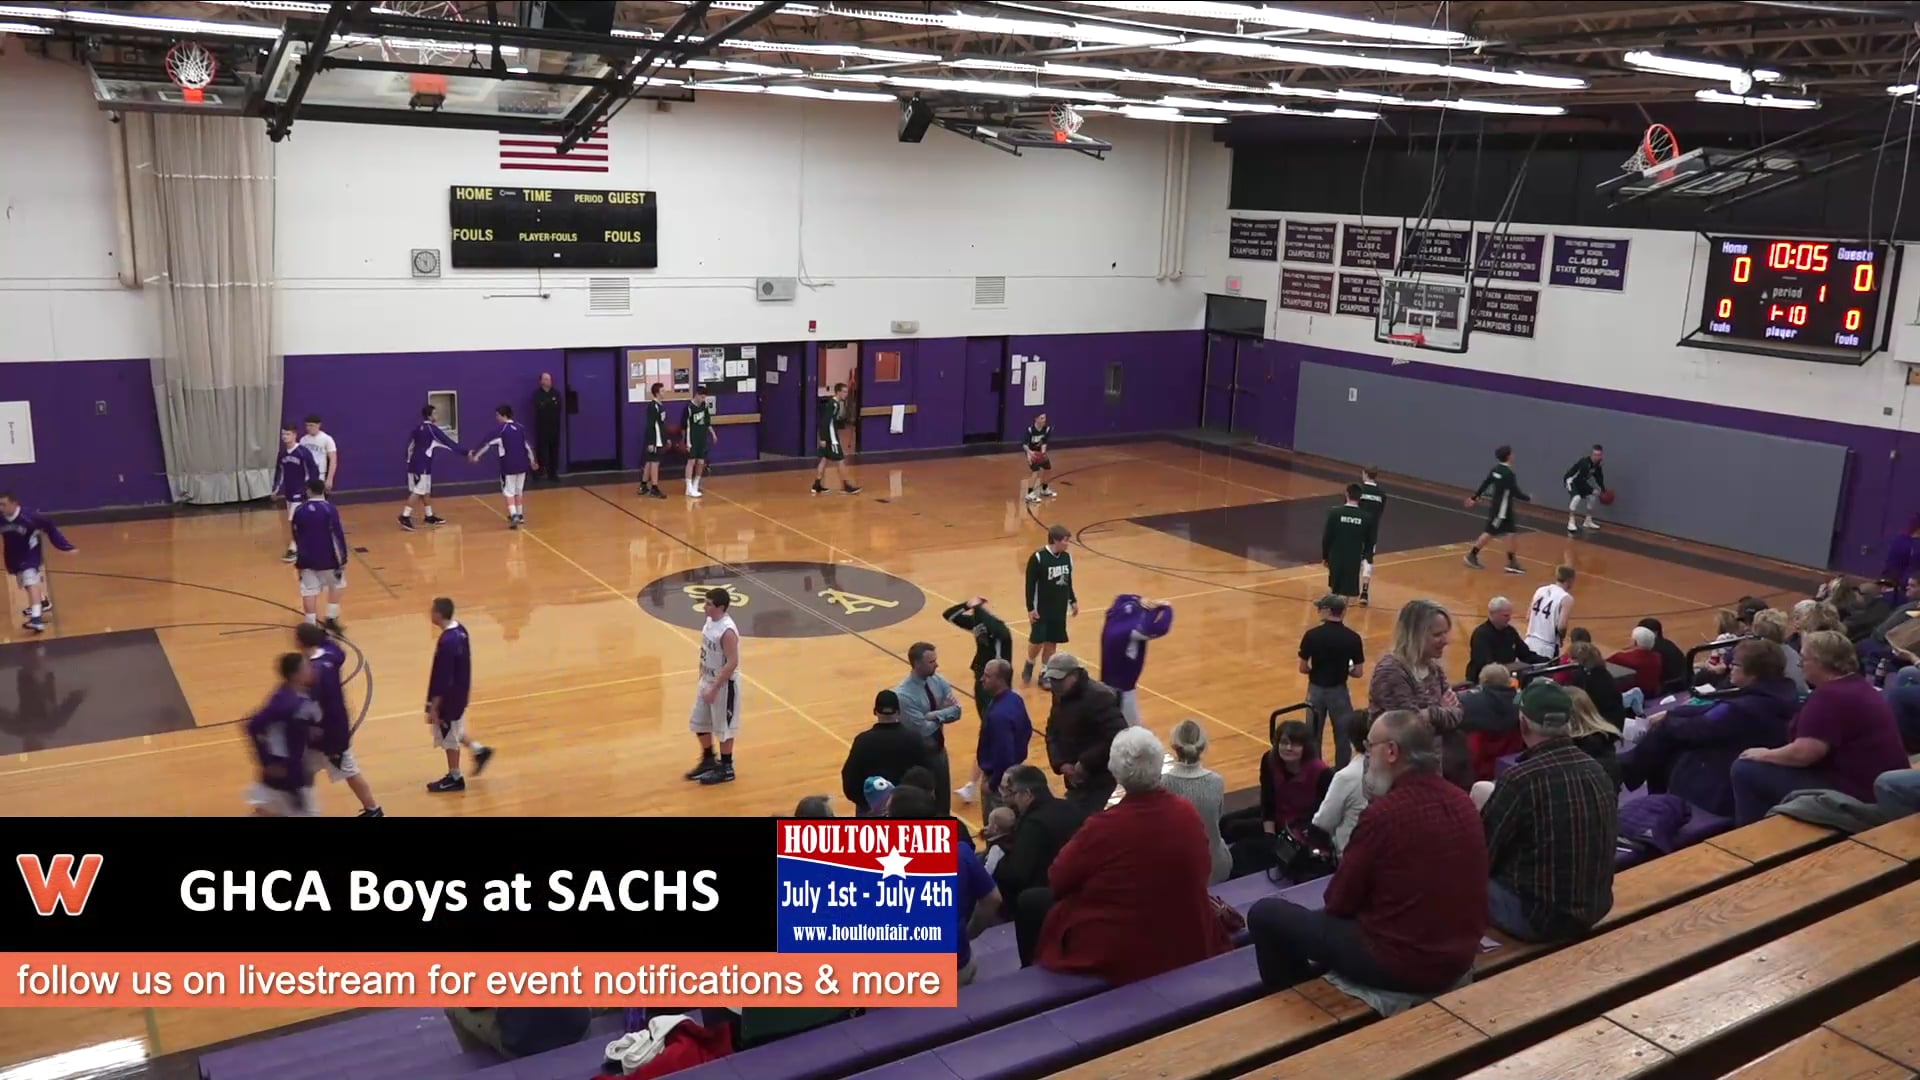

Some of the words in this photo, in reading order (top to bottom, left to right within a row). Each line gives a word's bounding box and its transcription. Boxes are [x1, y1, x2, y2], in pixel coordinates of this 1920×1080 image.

[456, 187, 493, 201] HOME
[522, 189, 552, 202] TIME
[574, 194, 603, 204] PERIOD
[608, 192, 646, 205] GUEST
[453, 228, 494, 241] FOULS
[519, 232, 578, 242] PLAYER-FOULS
[604, 230, 641, 243] FOULS
[1568, 256, 1599, 266] CLASS
[1601, 258, 1609, 267] D
[1721, 241, 1748, 255] Home
[1768, 242, 1829, 271] 10:05
[1555, 264, 1578, 274] STATE
[1580, 267, 1621, 278] CHAMPIONS
[1733, 256, 1751, 283] 0
[1853, 264, 1873, 292] 0
[1772, 287, 1803, 299] period
[1819, 285, 1826, 302] 1
[1283, 297, 1313, 308] CHAMPIONS
[1340, 303, 1370, 313] CHAMPIONS
[1413, 299, 1436, 308] CLSS
[1718, 298, 1732, 318] 0
[1845, 309, 1860, 330] 0
[1709, 320, 1731, 333] fouls
[1765, 325, 1798, 339] player
[1835, 332, 1859, 346] fouls
[1532, 595, 1554, 620] 44
